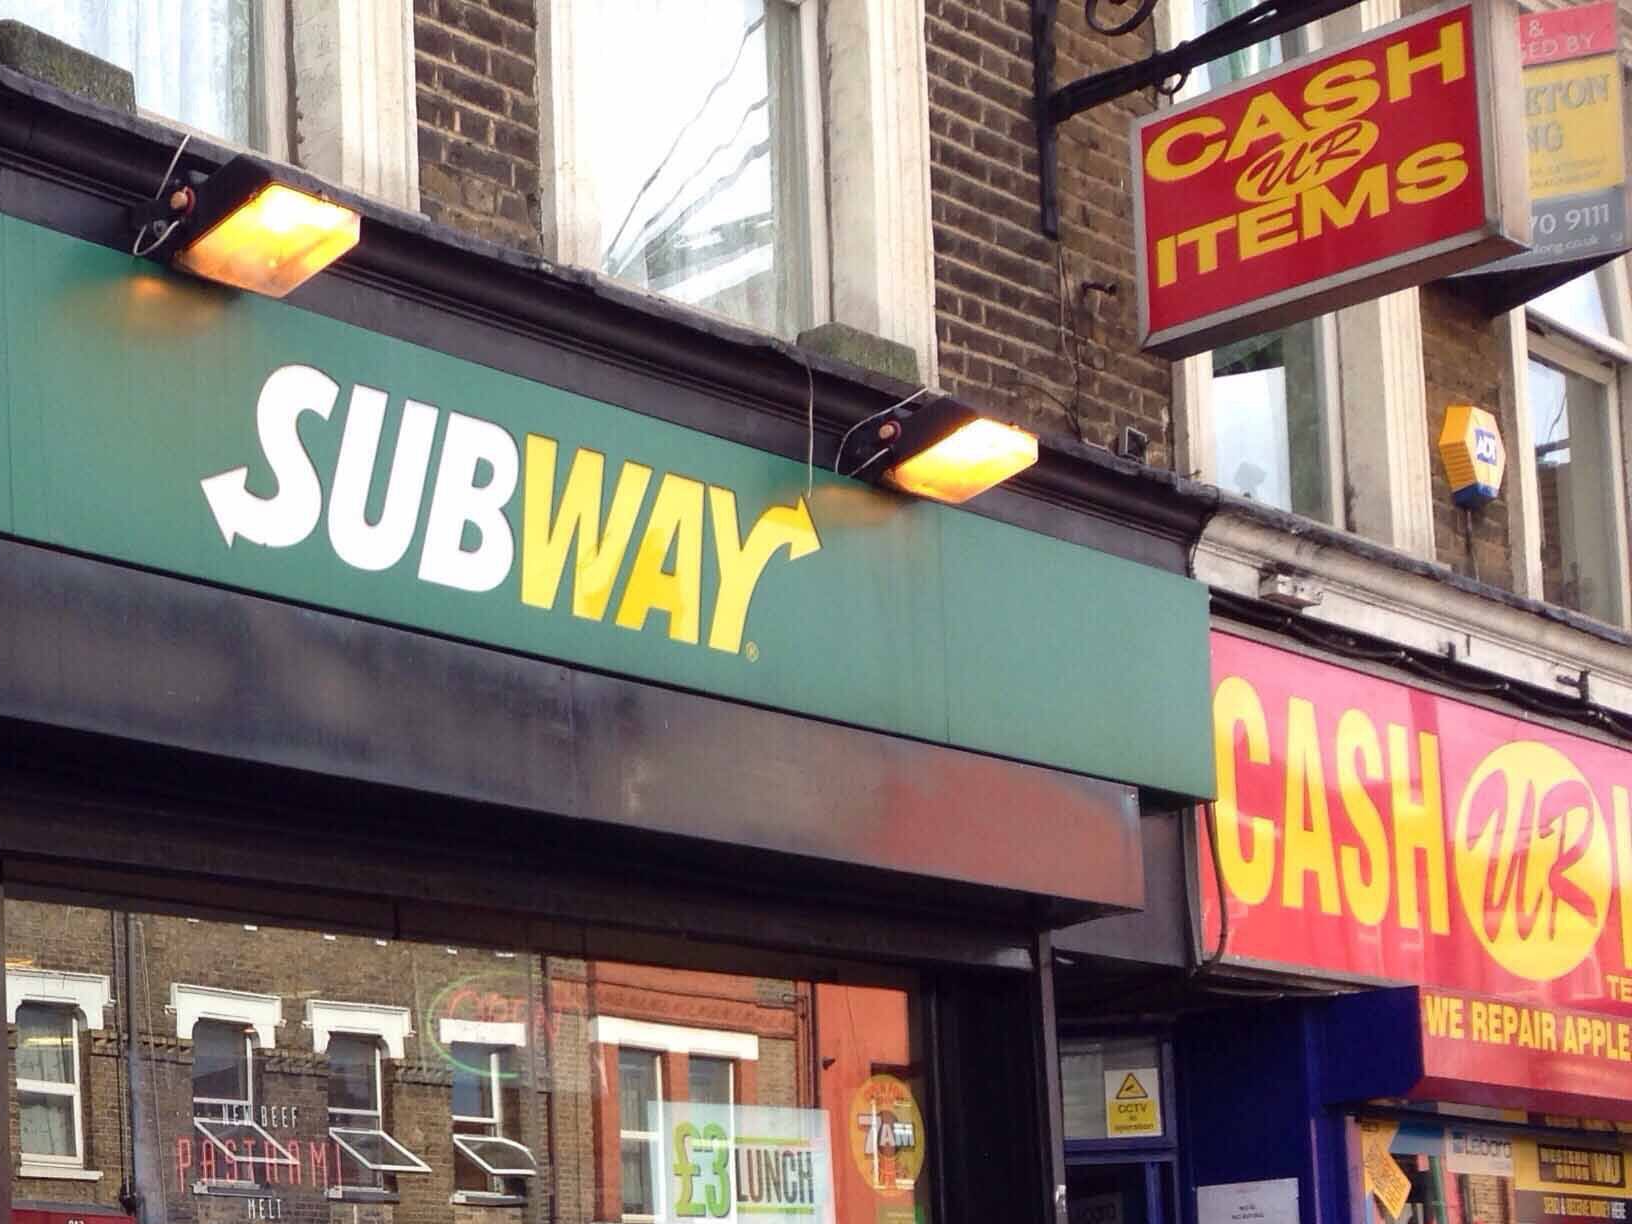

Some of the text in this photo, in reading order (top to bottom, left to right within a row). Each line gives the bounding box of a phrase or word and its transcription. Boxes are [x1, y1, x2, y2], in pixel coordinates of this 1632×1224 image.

[1145, 22, 1467, 182] CASH
[1157, 142, 1469, 288] ITEMS
[200, 363, 822, 654] SUBWAY
[1213, 676, 1450, 936] CASH
[1425, 994, 1632, 1062] WE REPAIR APPLE
[260, 1105, 298, 1128] BEEF
[1118, 1102, 1148, 1114] CCTV
[176, 1135, 343, 1195] PASTRAMI
[673, 1120, 732, 1219] £3
[736, 1148, 815, 1205] LUNCH
[247, 1198, 283, 1220] MELT
